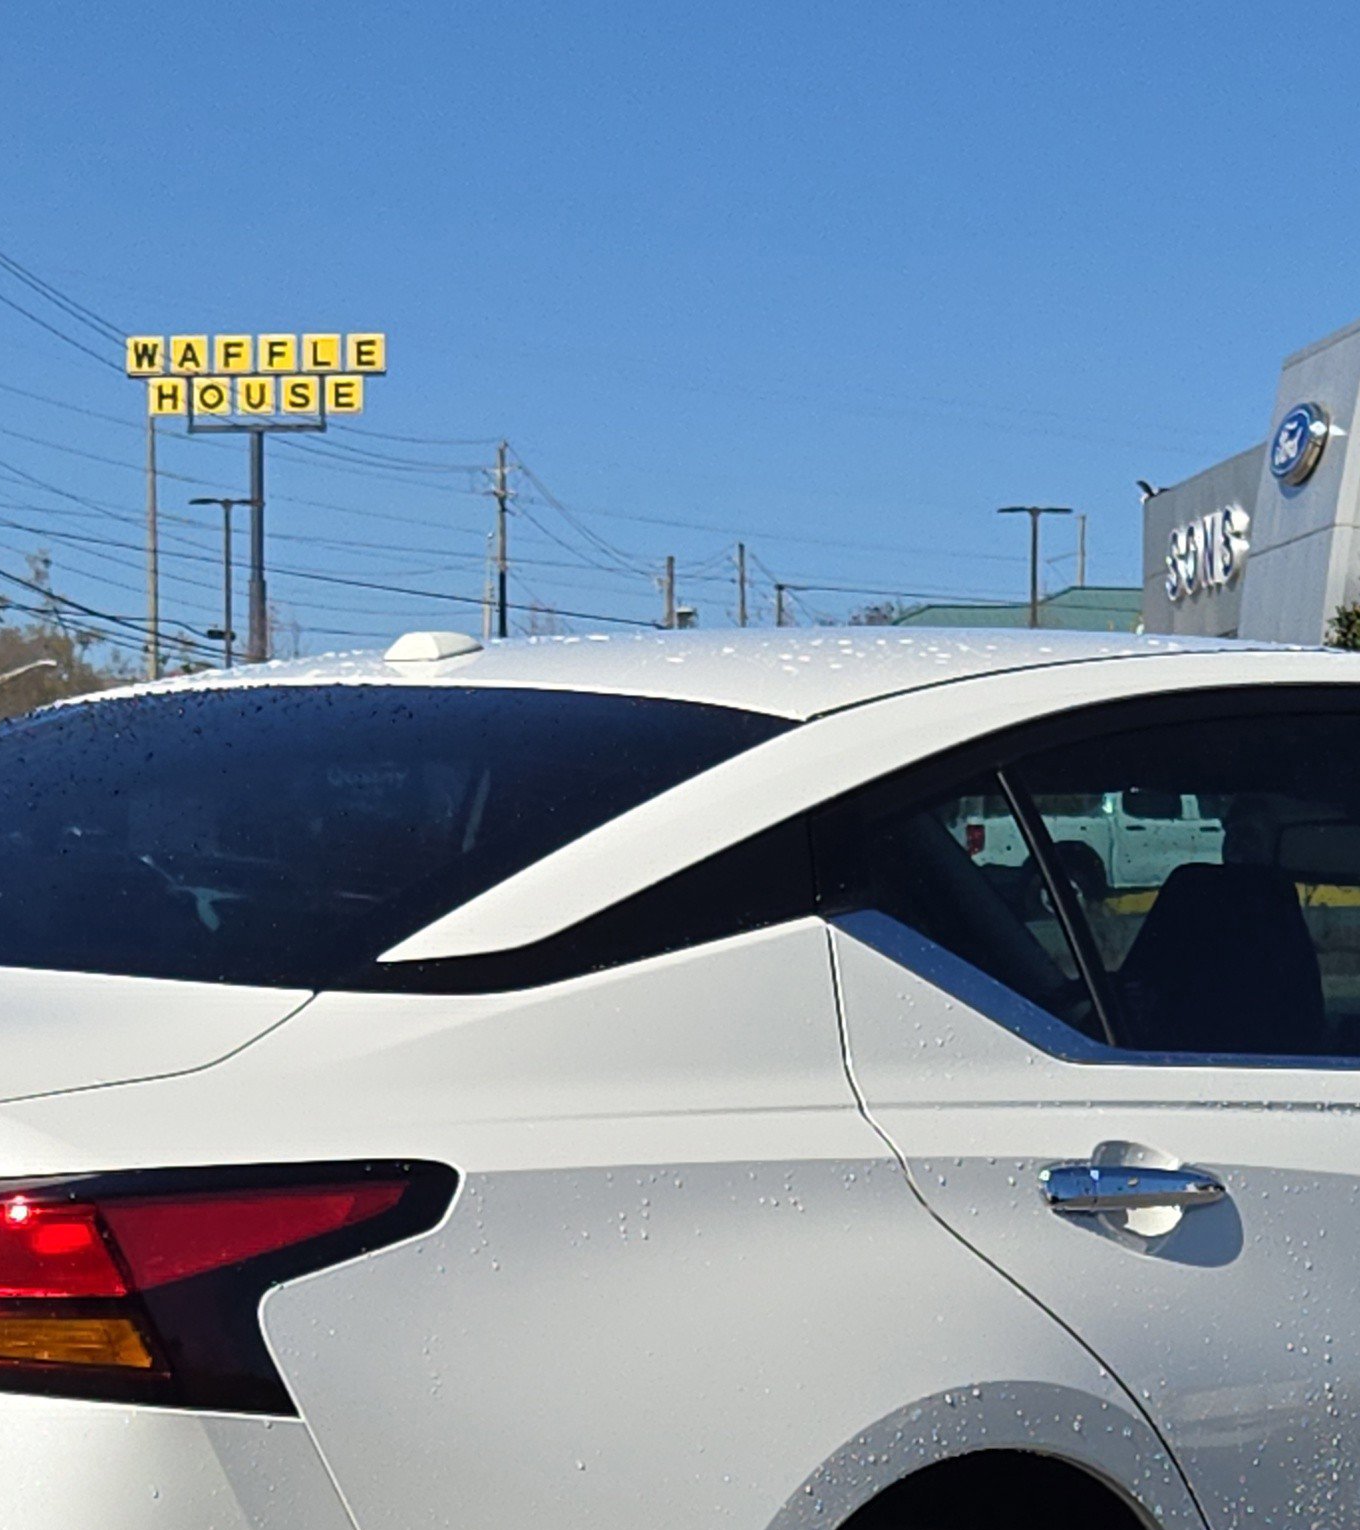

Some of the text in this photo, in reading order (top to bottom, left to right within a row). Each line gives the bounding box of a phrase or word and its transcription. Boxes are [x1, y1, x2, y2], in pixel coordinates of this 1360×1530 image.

[133, 339, 377, 368] WAFFLE
[157, 382, 355, 411] HOUSE
[1274, 421, 1304, 466] Ford
[1165, 505, 1251, 601] SONS
